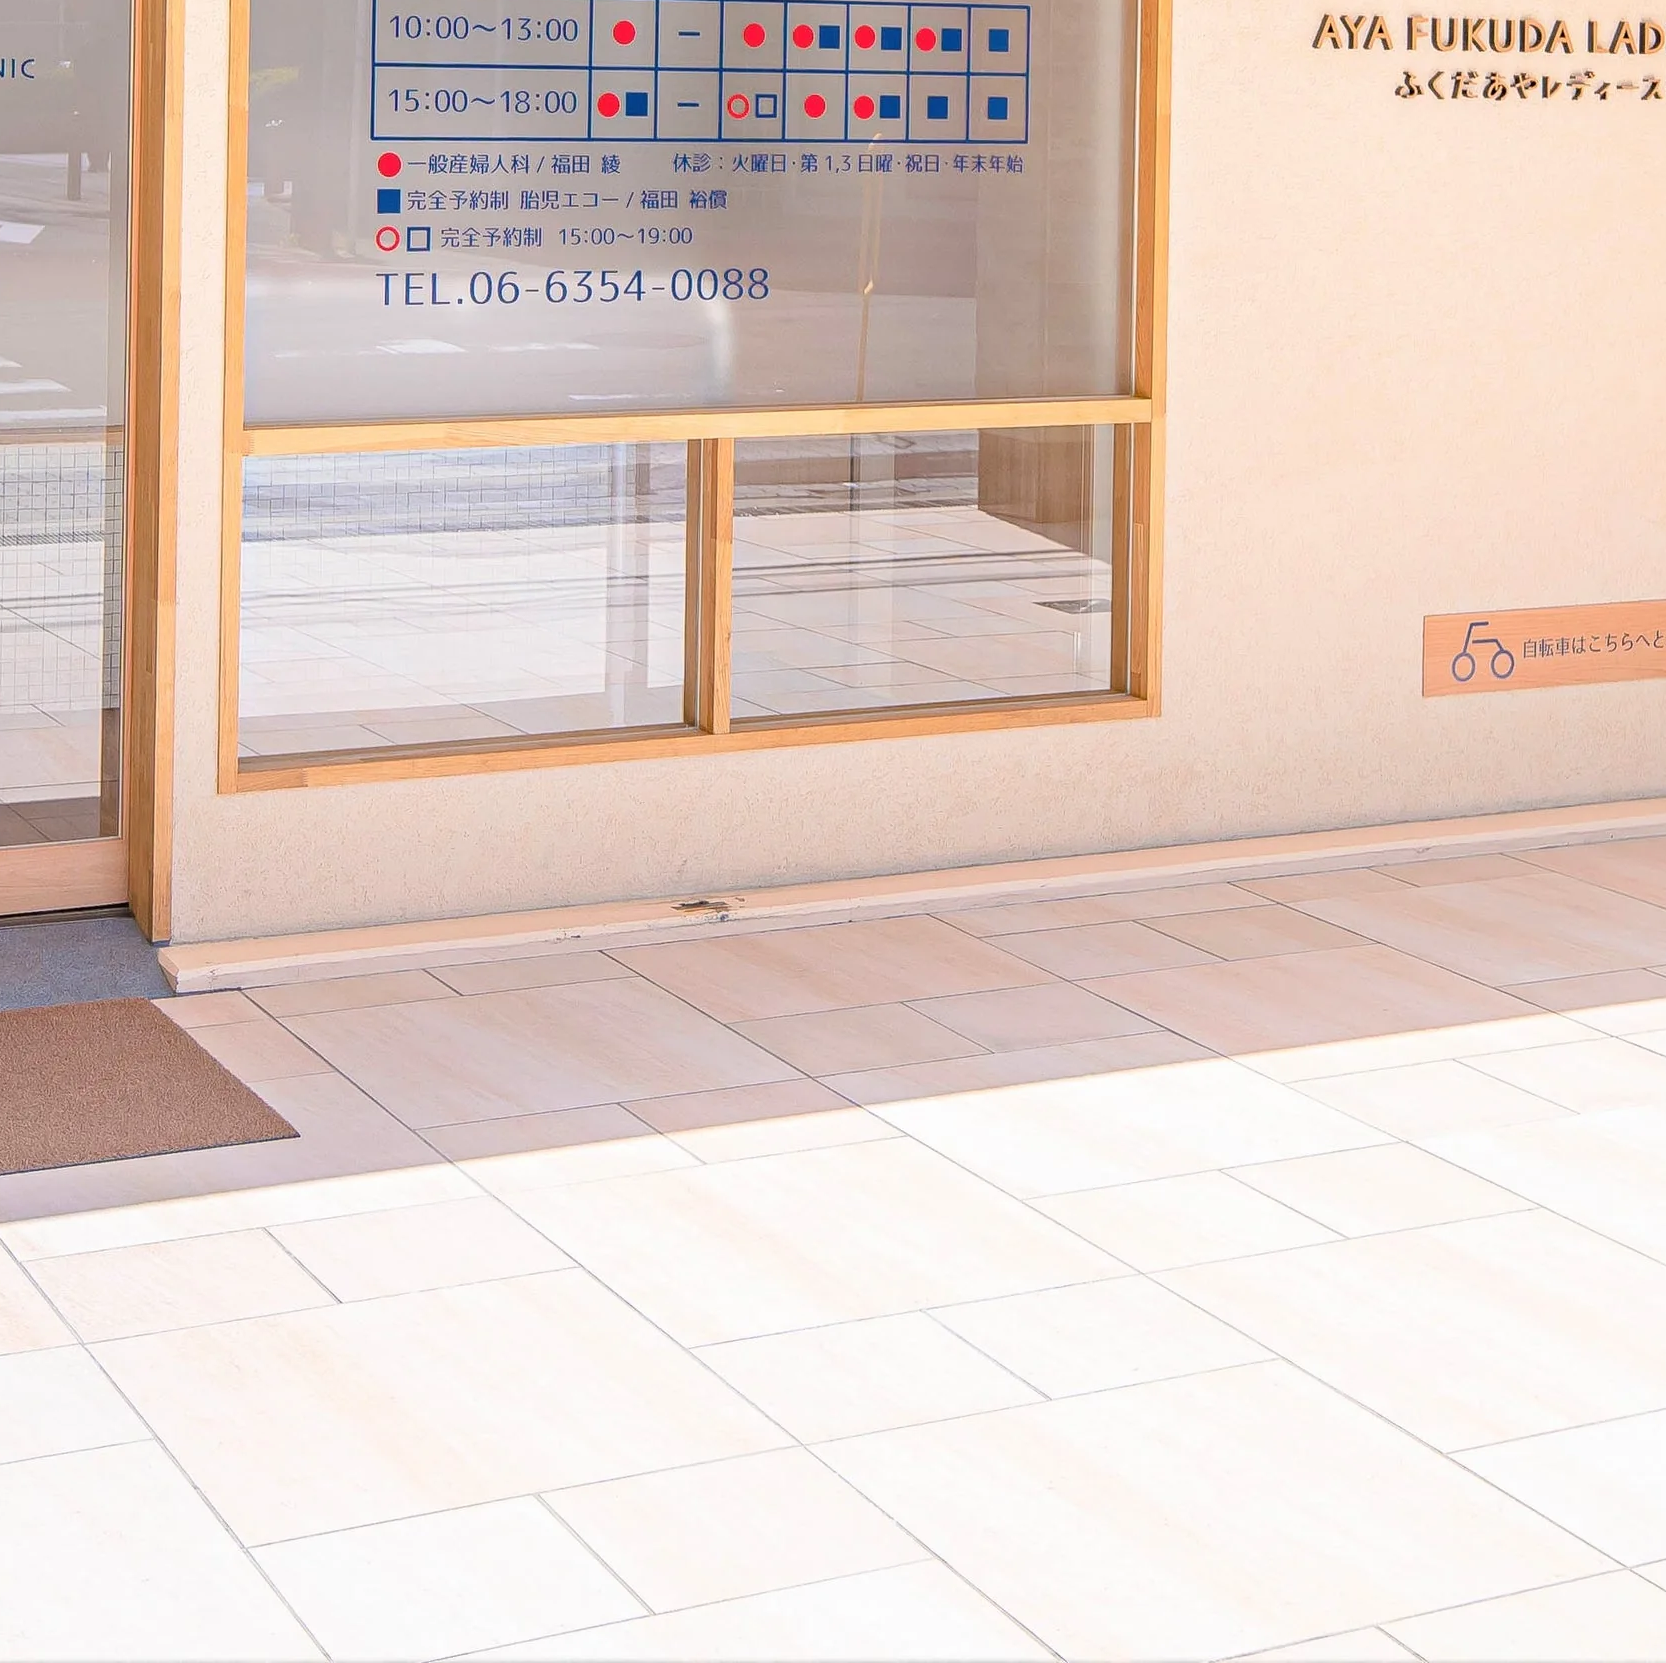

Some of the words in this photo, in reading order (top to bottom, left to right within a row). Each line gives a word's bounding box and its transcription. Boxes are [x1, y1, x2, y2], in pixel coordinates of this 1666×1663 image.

[1312, 13, 1394, 52] AYA
[1406, 15, 1574, 55] FUKUDA
[407, 189, 509, 211] 完全予約制
[440, 227, 542, 248] 完全予約制
[375, 266, 771, 306] TEL.06-6354-0088
